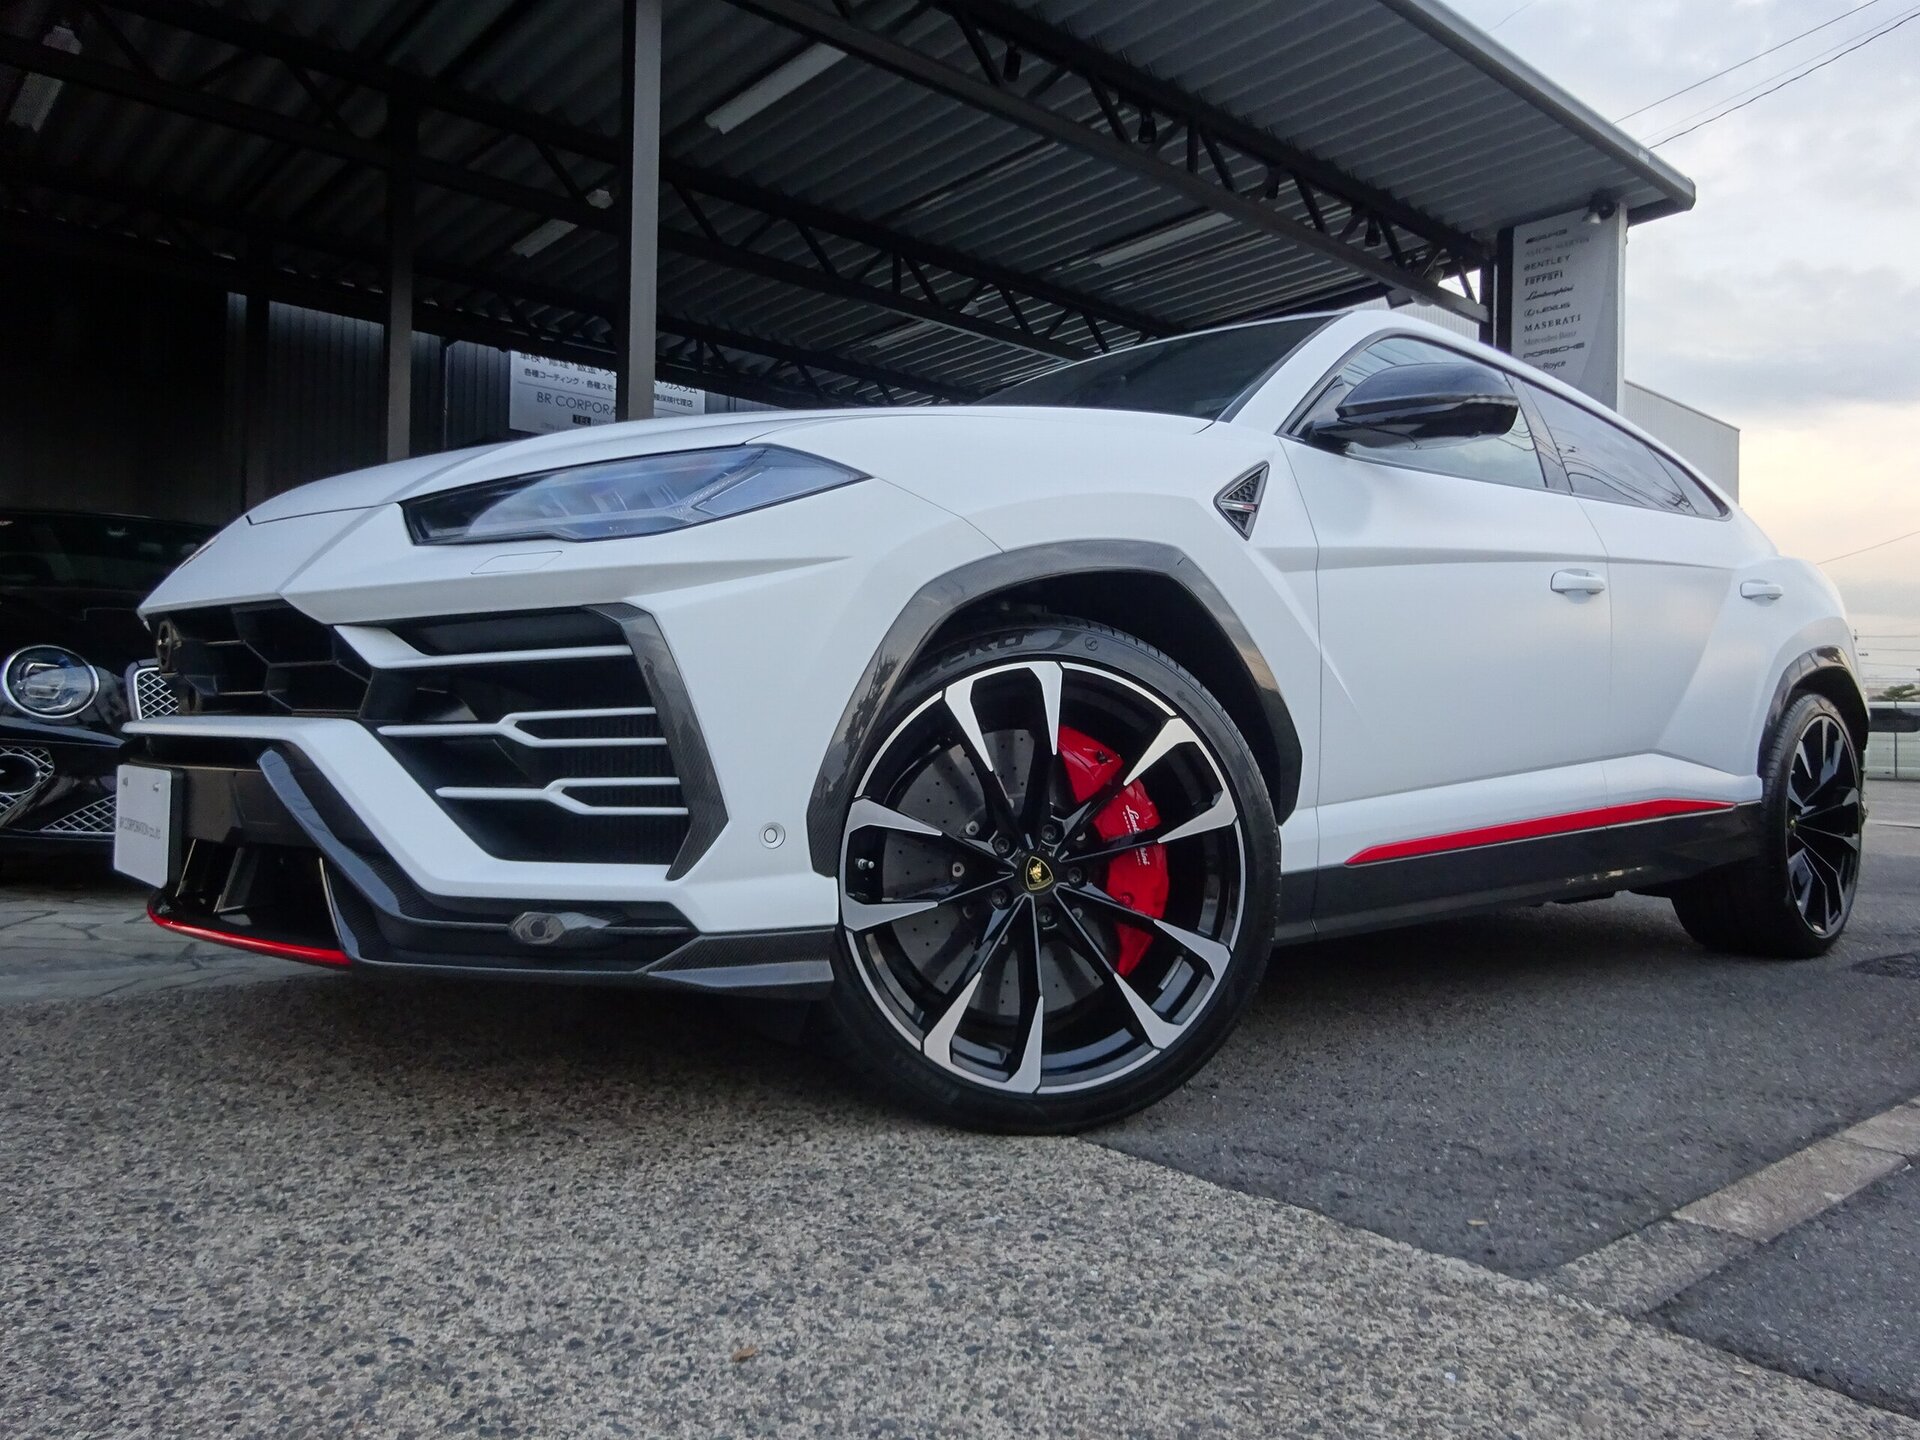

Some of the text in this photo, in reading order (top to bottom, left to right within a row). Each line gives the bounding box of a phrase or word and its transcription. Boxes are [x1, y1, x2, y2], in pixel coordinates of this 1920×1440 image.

[1524, 254, 1571, 271] BENTLEY
[1524, 314, 1581, 332] MASERATI
[1523, 342, 1585, 359] PORSCHE
[537, 392, 552, 405] BR
